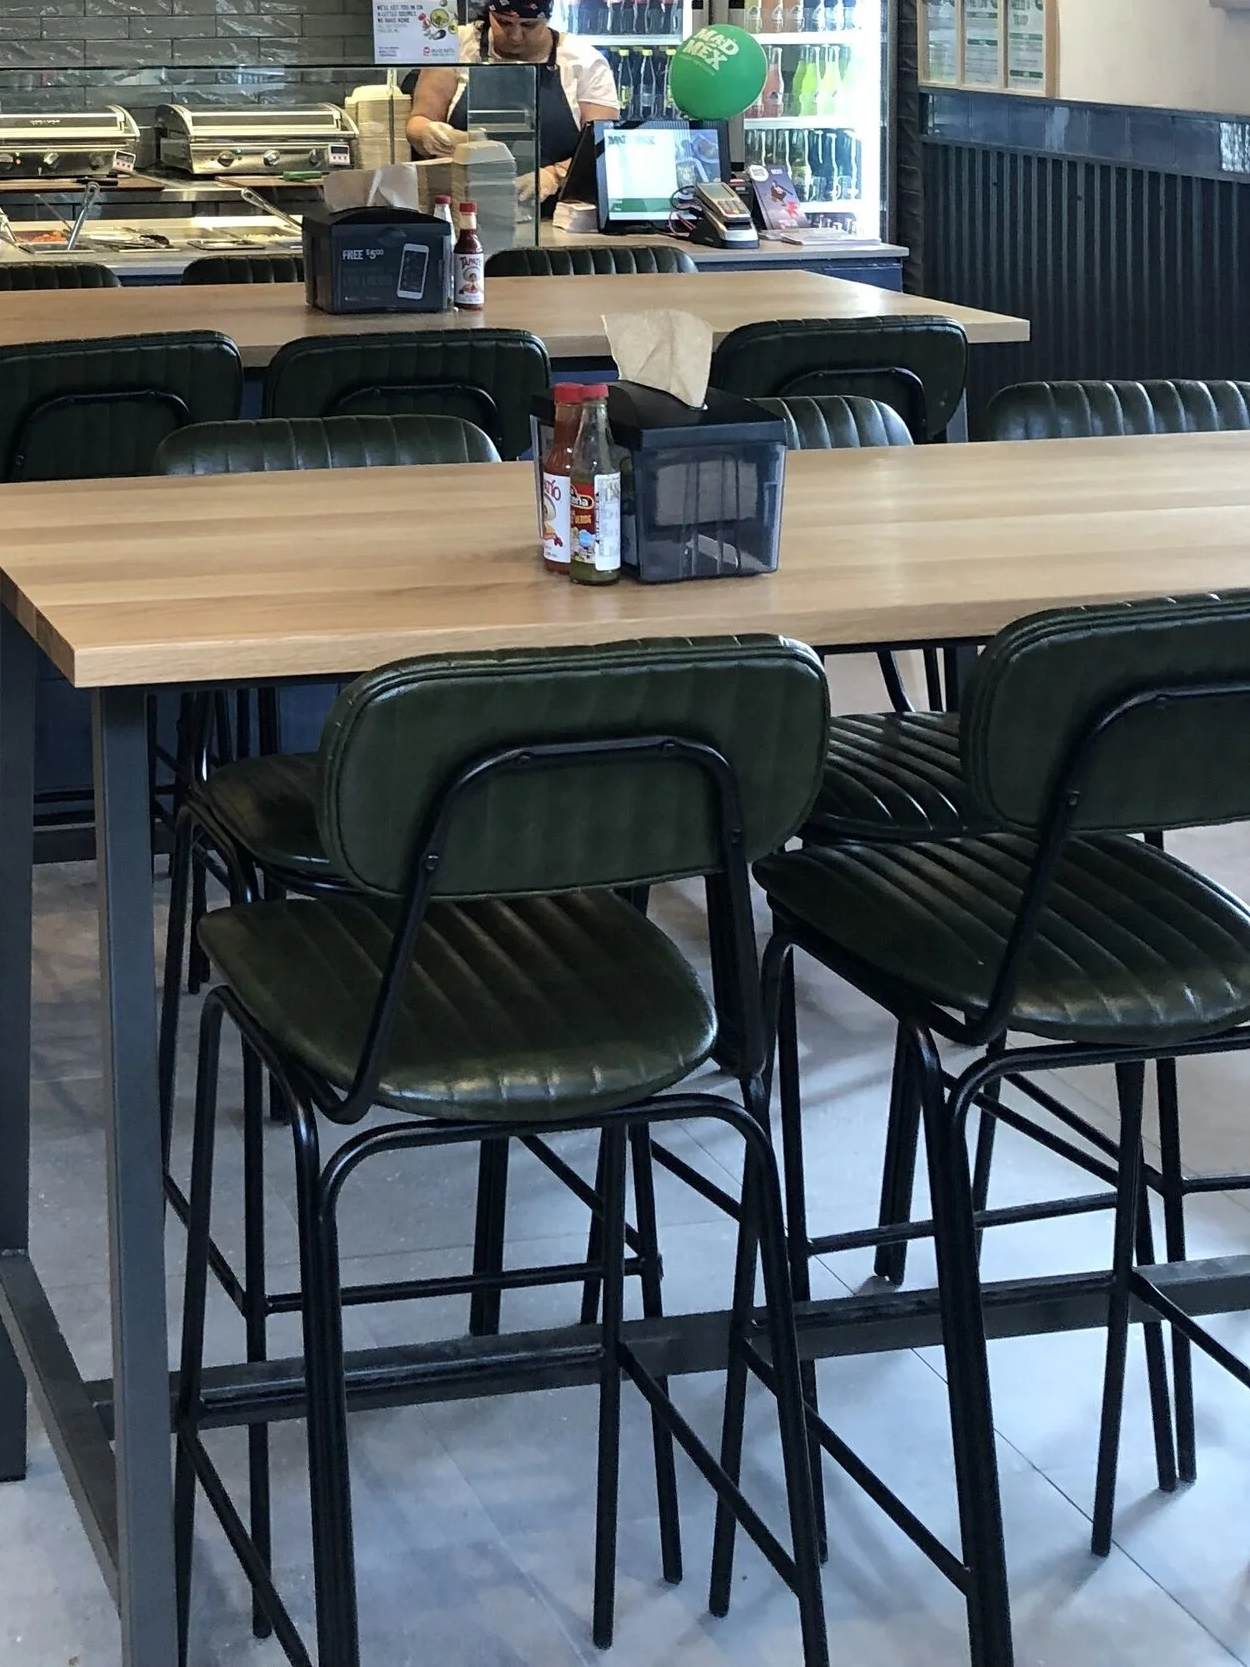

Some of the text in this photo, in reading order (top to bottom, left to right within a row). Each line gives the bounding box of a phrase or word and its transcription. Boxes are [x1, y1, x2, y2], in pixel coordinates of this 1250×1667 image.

[682, 40, 728, 70] MEX
[694, 28, 739, 55] MAD
[342, 250, 363, 260] FREE
